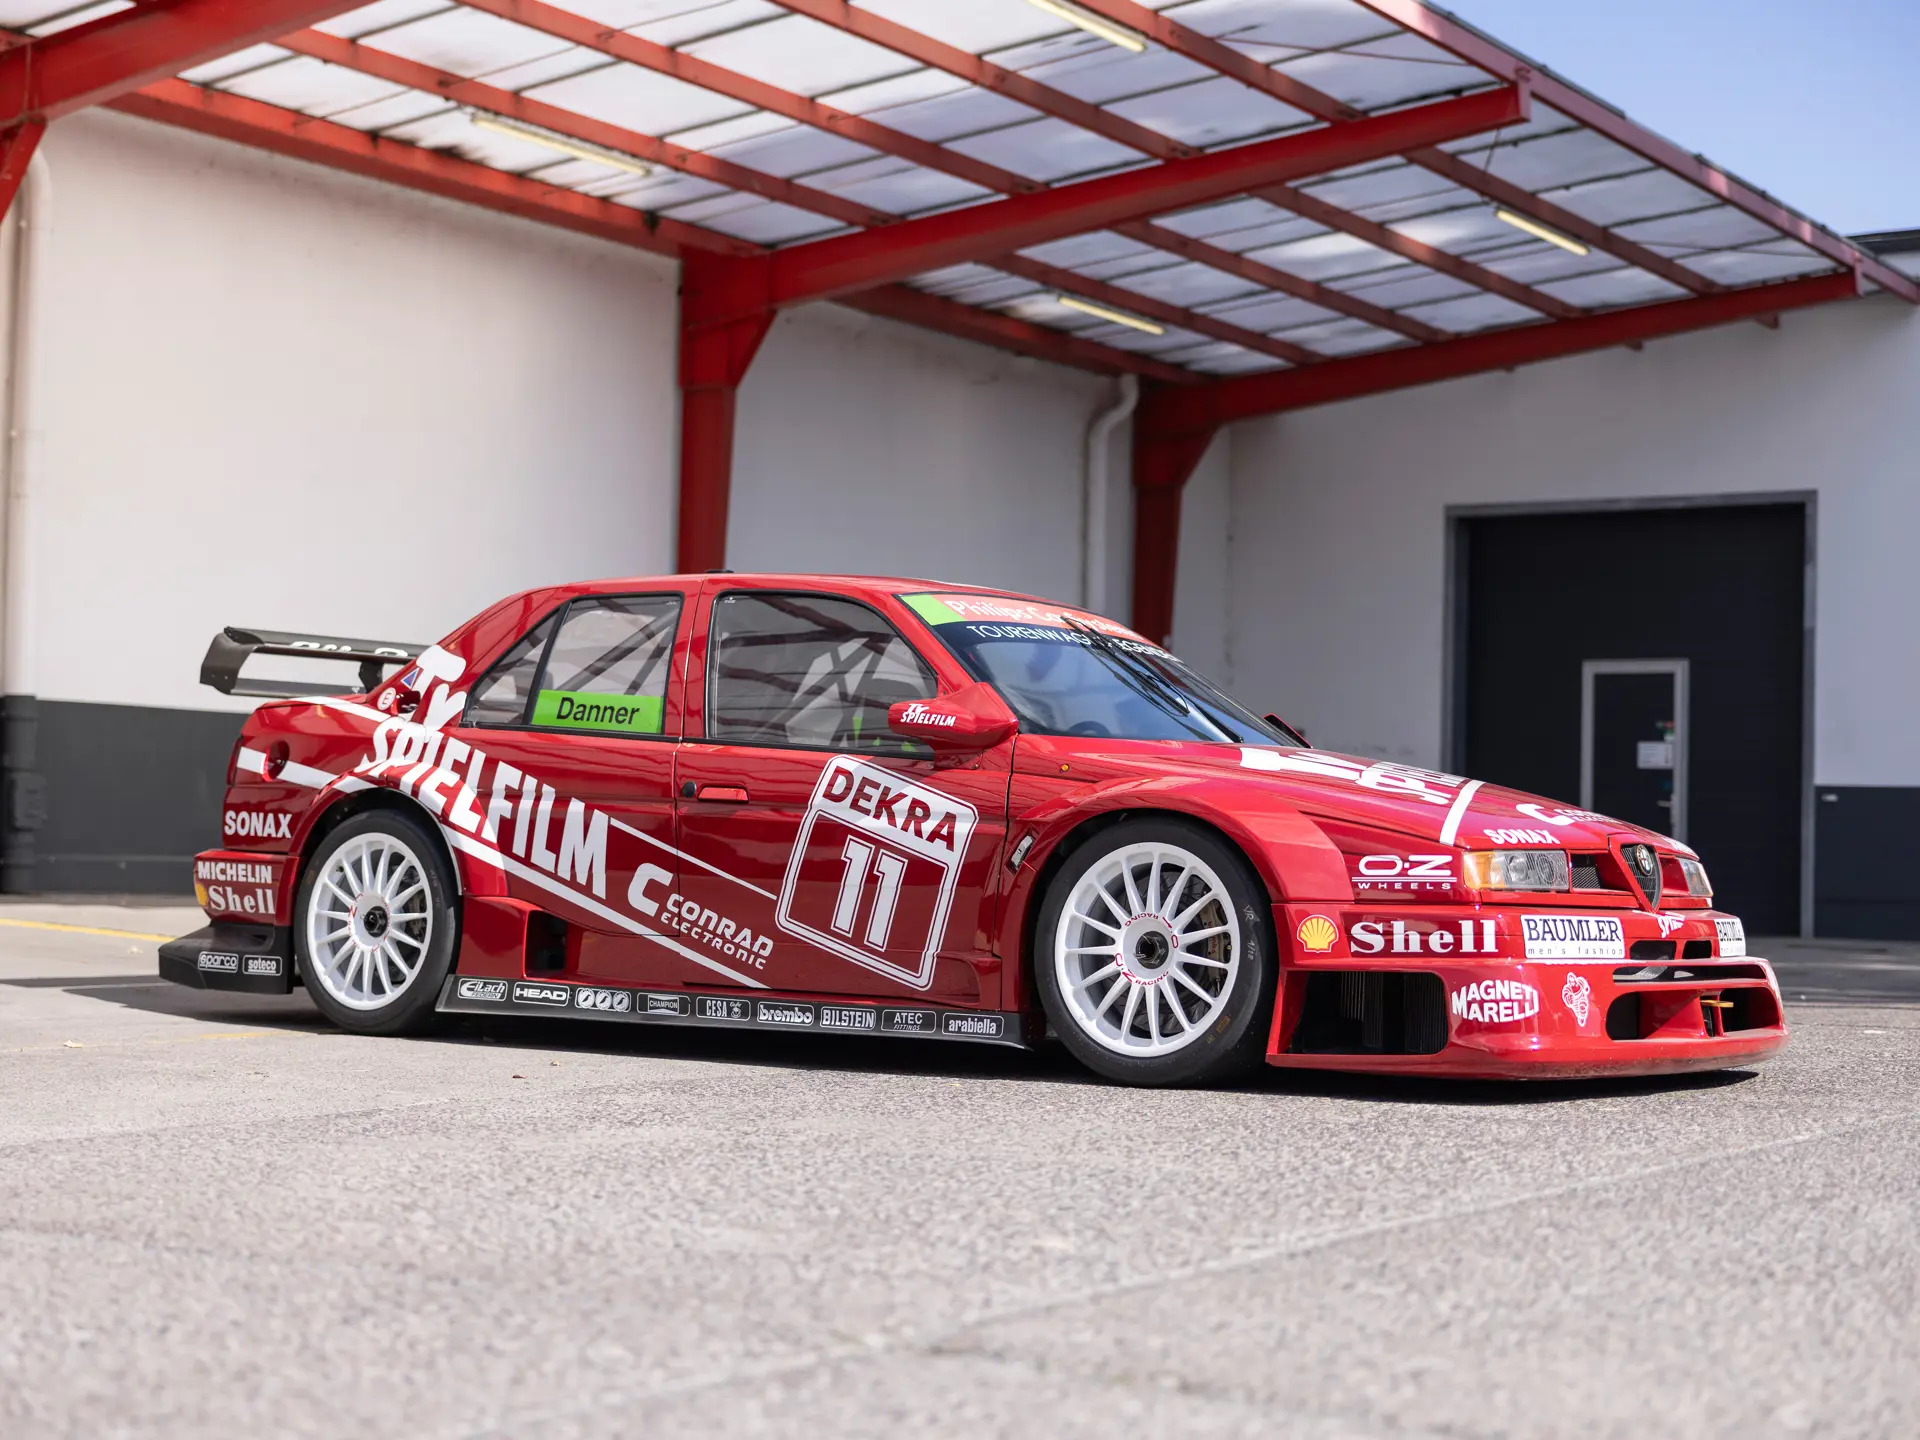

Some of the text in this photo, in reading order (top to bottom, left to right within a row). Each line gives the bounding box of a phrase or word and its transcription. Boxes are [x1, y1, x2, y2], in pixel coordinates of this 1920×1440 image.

[556, 697, 640, 725] Danner
[900, 711, 956, 727] SPIELFILM
[354, 716, 609, 900] SPIELFILM
[822, 766, 957, 852] DEKRA
[224, 810, 292, 838] SONAX
[1483, 828, 1560, 845] SONAX
[198, 861, 272, 884] MICHELIN
[208, 885, 276, 914] Shell
[830, 834, 909, 952] 11
[667, 893, 774, 957] CONRAD
[660, 911, 767, 970] ELECTRONIC
[1351, 919, 1499, 954] Shell
[200, 953, 237, 969] sparco
[1528, 947, 1623, 956] men's fashion
[248, 957, 277, 971] soteco
[515, 987, 567, 1001] HEAD
[649, 1000, 678, 1009] CHAMPION
[706, 999, 728, 1018] CESA
[759, 1004, 813, 1024] brembo
[822, 1009, 875, 1028] BILSTEIN
[894, 1012, 923, 1025] ATEC
[948, 1019, 997, 1035] arabiella
